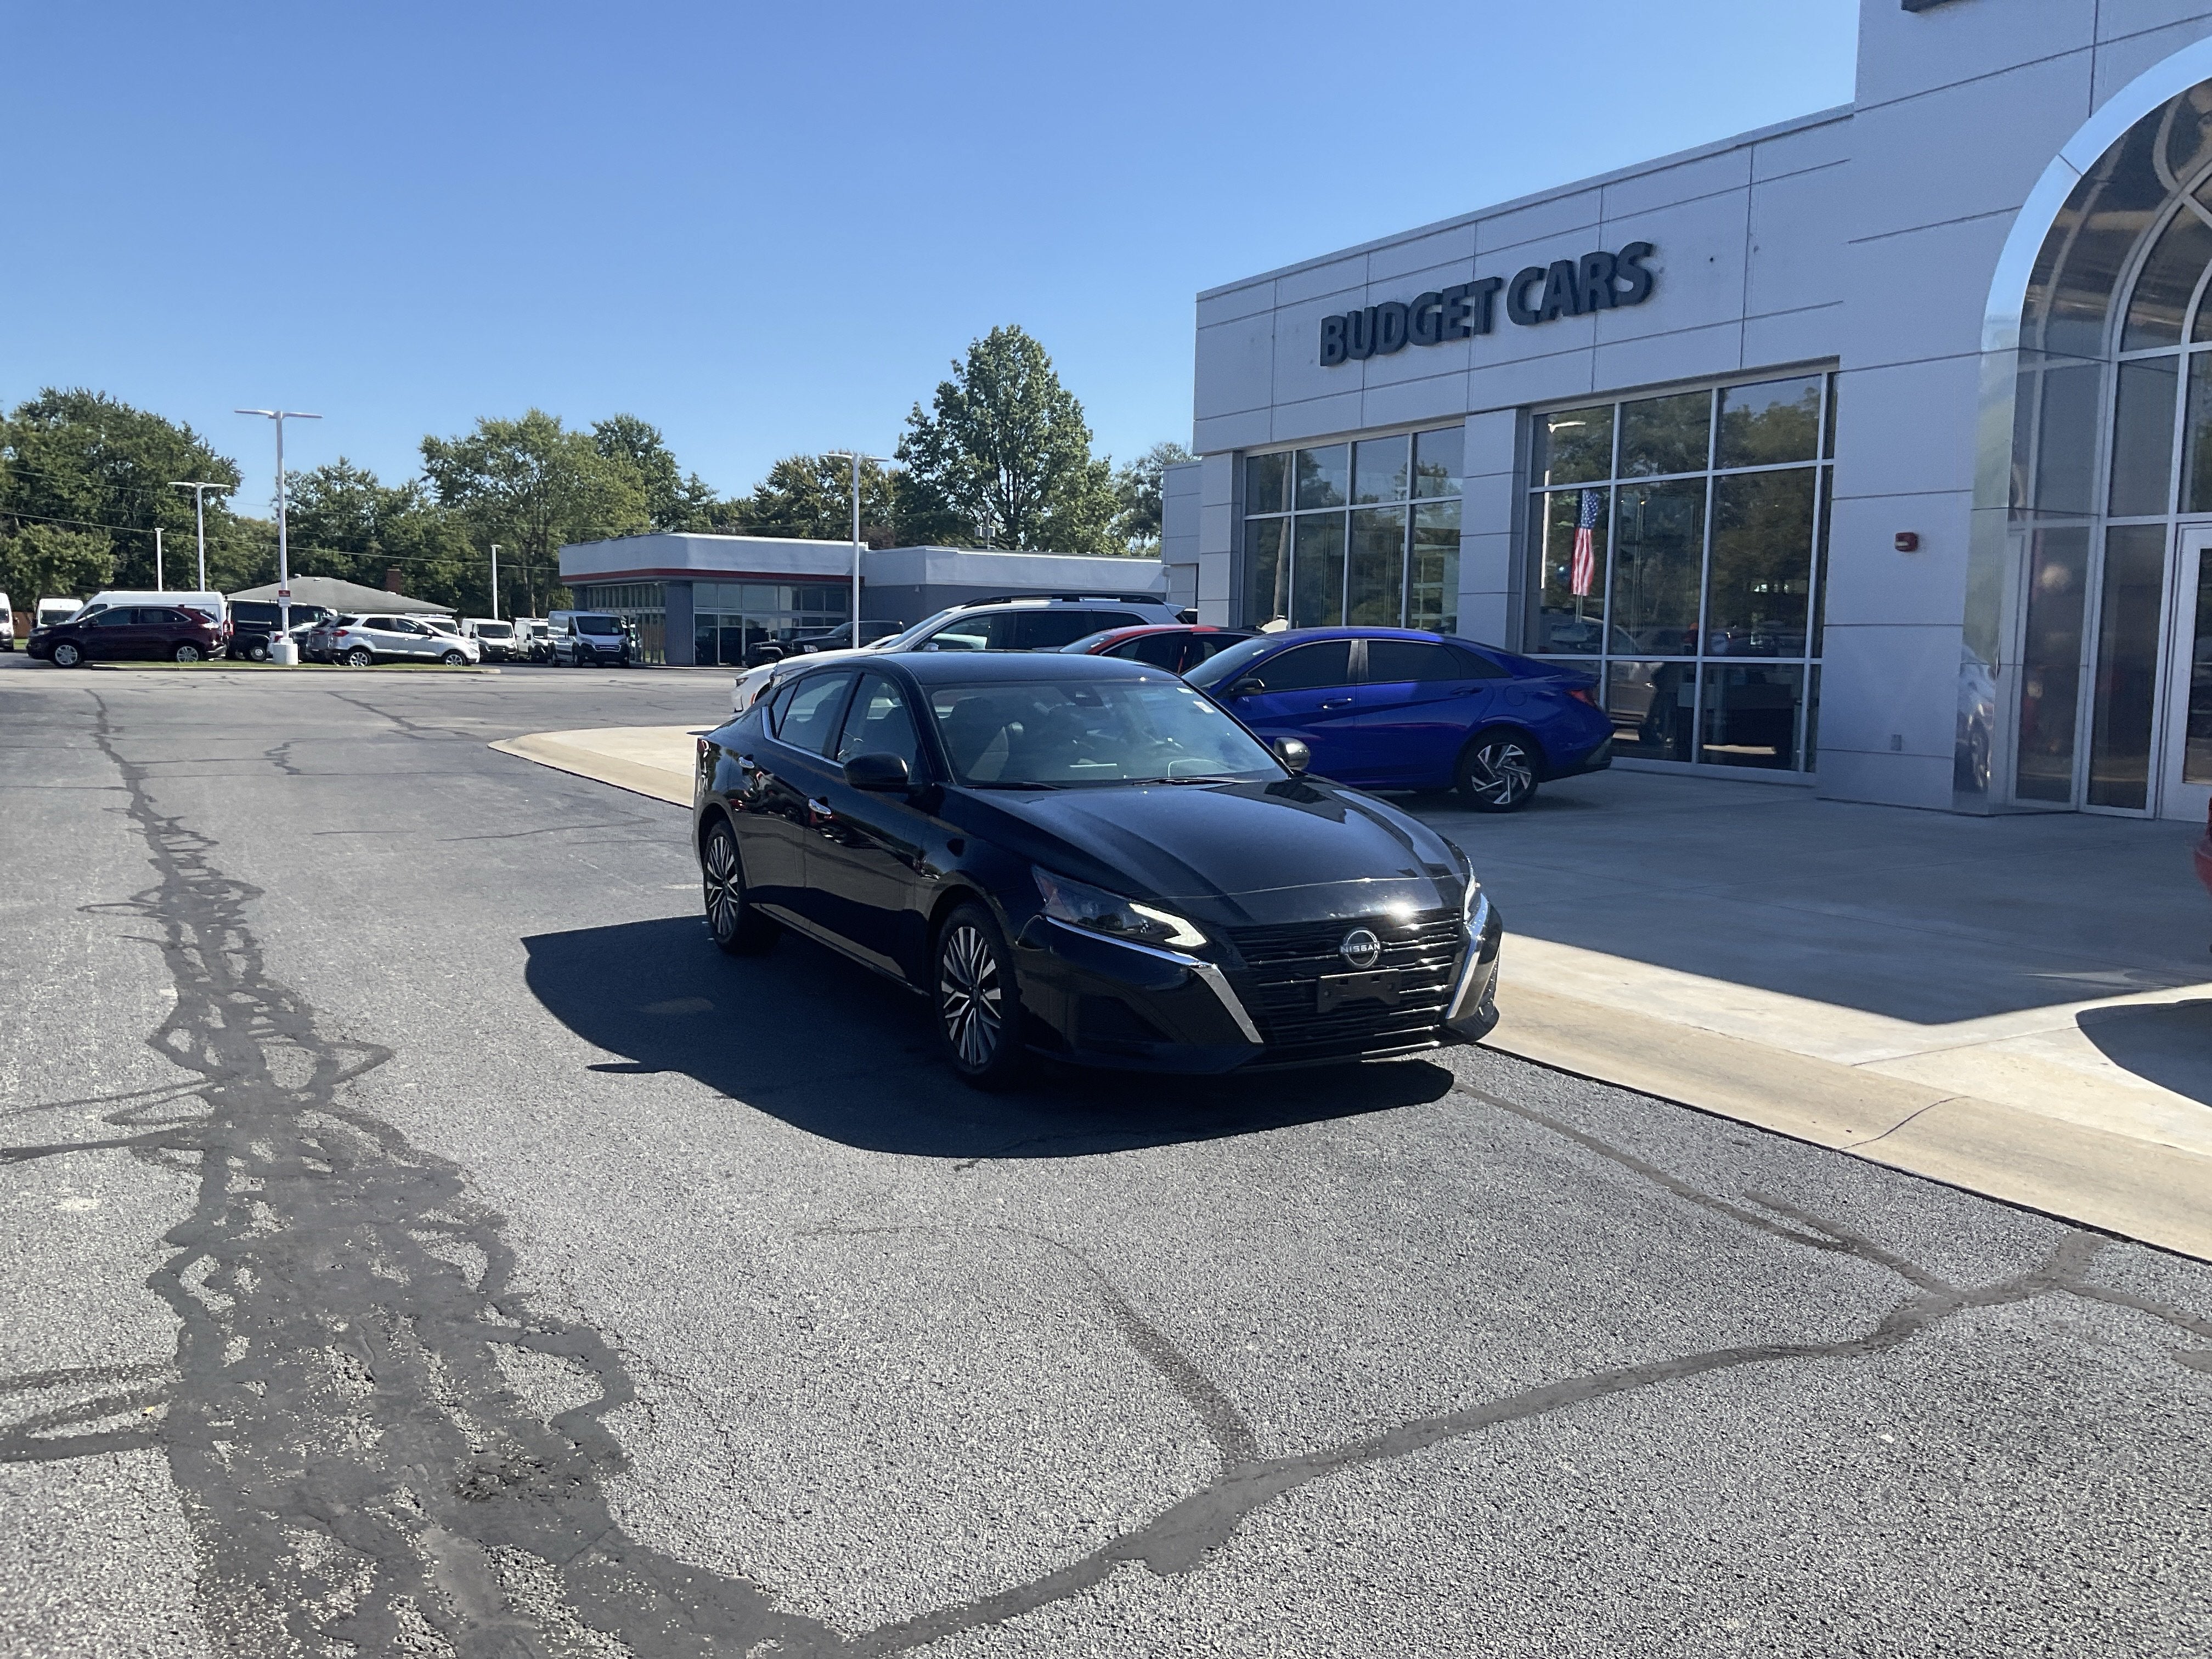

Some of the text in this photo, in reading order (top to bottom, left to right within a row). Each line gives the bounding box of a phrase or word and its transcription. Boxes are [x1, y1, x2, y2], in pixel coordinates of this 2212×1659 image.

[1320, 241, 1654, 366] BUDGET CARS
[1341, 943, 1380, 953] NISSAN
